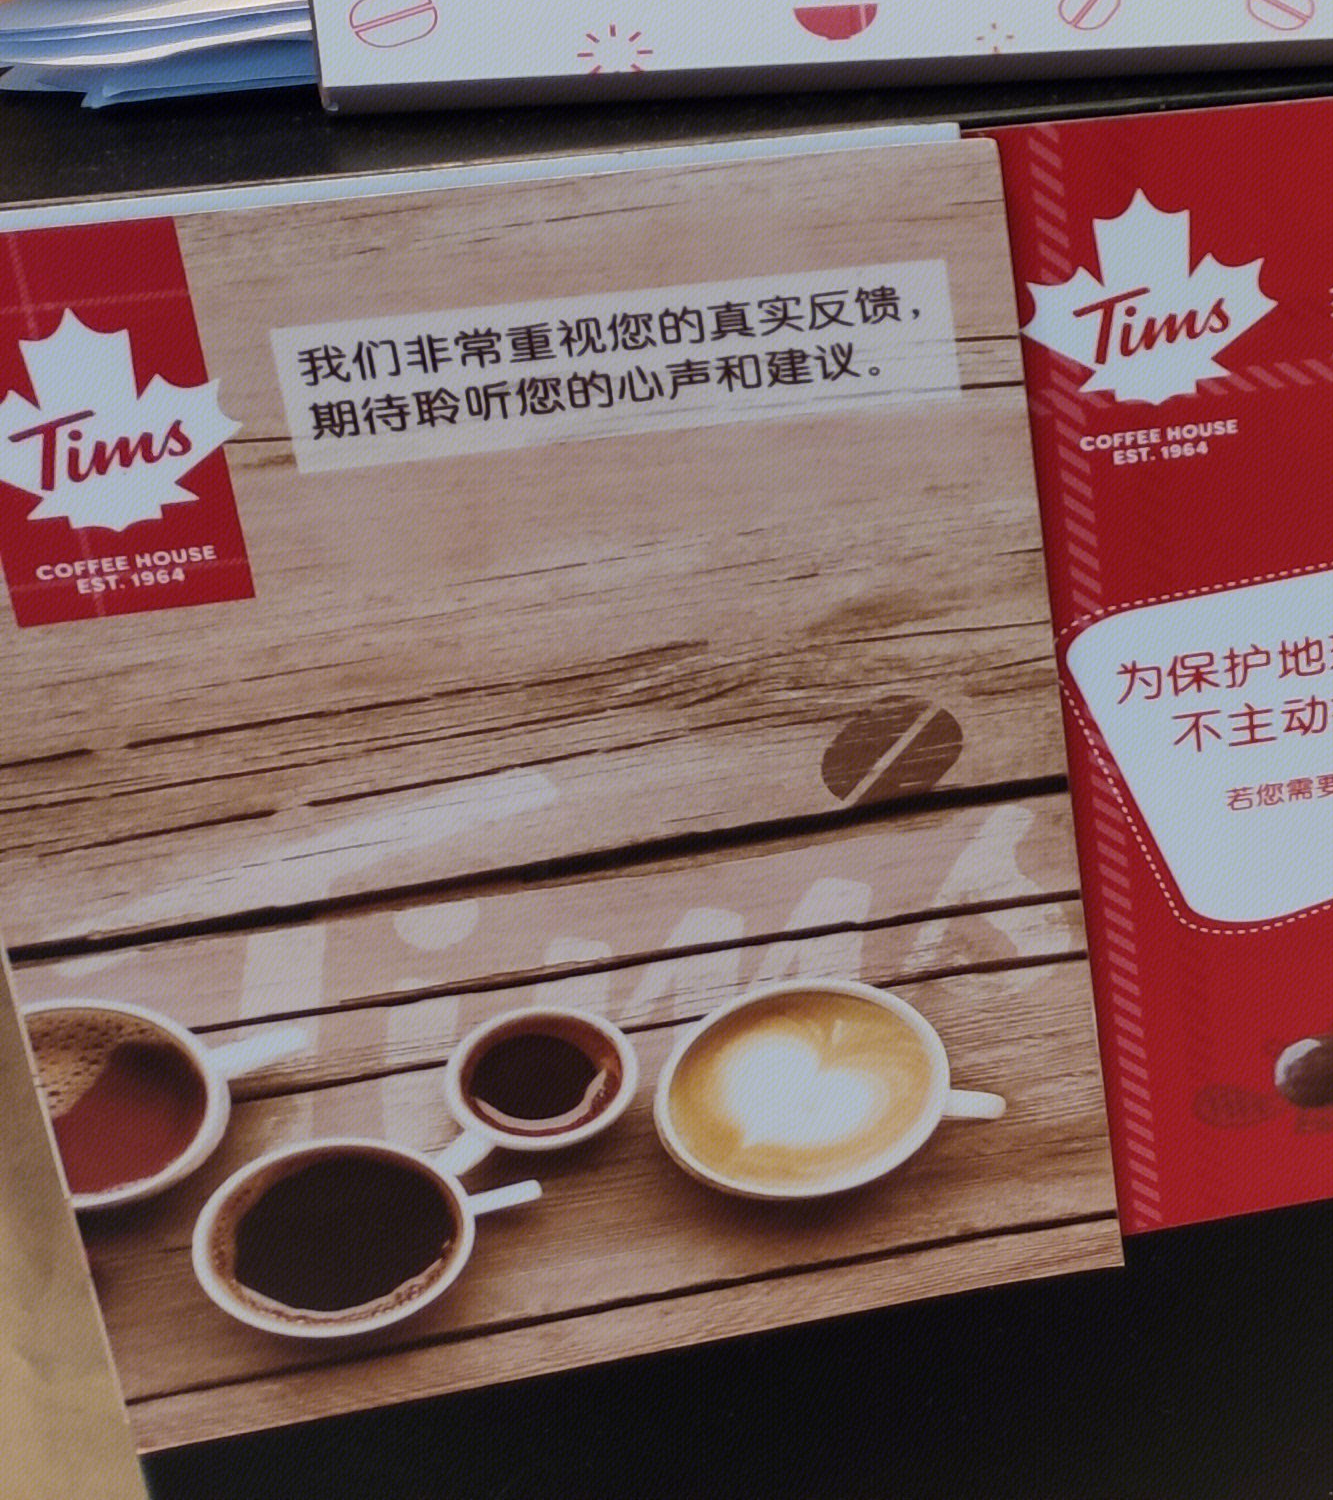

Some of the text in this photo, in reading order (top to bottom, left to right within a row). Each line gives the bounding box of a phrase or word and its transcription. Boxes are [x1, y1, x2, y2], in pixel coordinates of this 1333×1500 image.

[298, 284, 924, 386] 我们非常重视您的真实反馈，
[1074, 287, 1231, 365] Tims
[311, 341, 884, 441] 期待聆听您的心声和建议。
[8, 409, 193, 492] Tims
[1079, 419, 1238, 452] COFFEE HOUSE
[1113, 440, 1209, 466] EST. 1964
[36, 544, 216, 581] COFFEE HOUSE
[76, 567, 187, 595] EST. 1964
